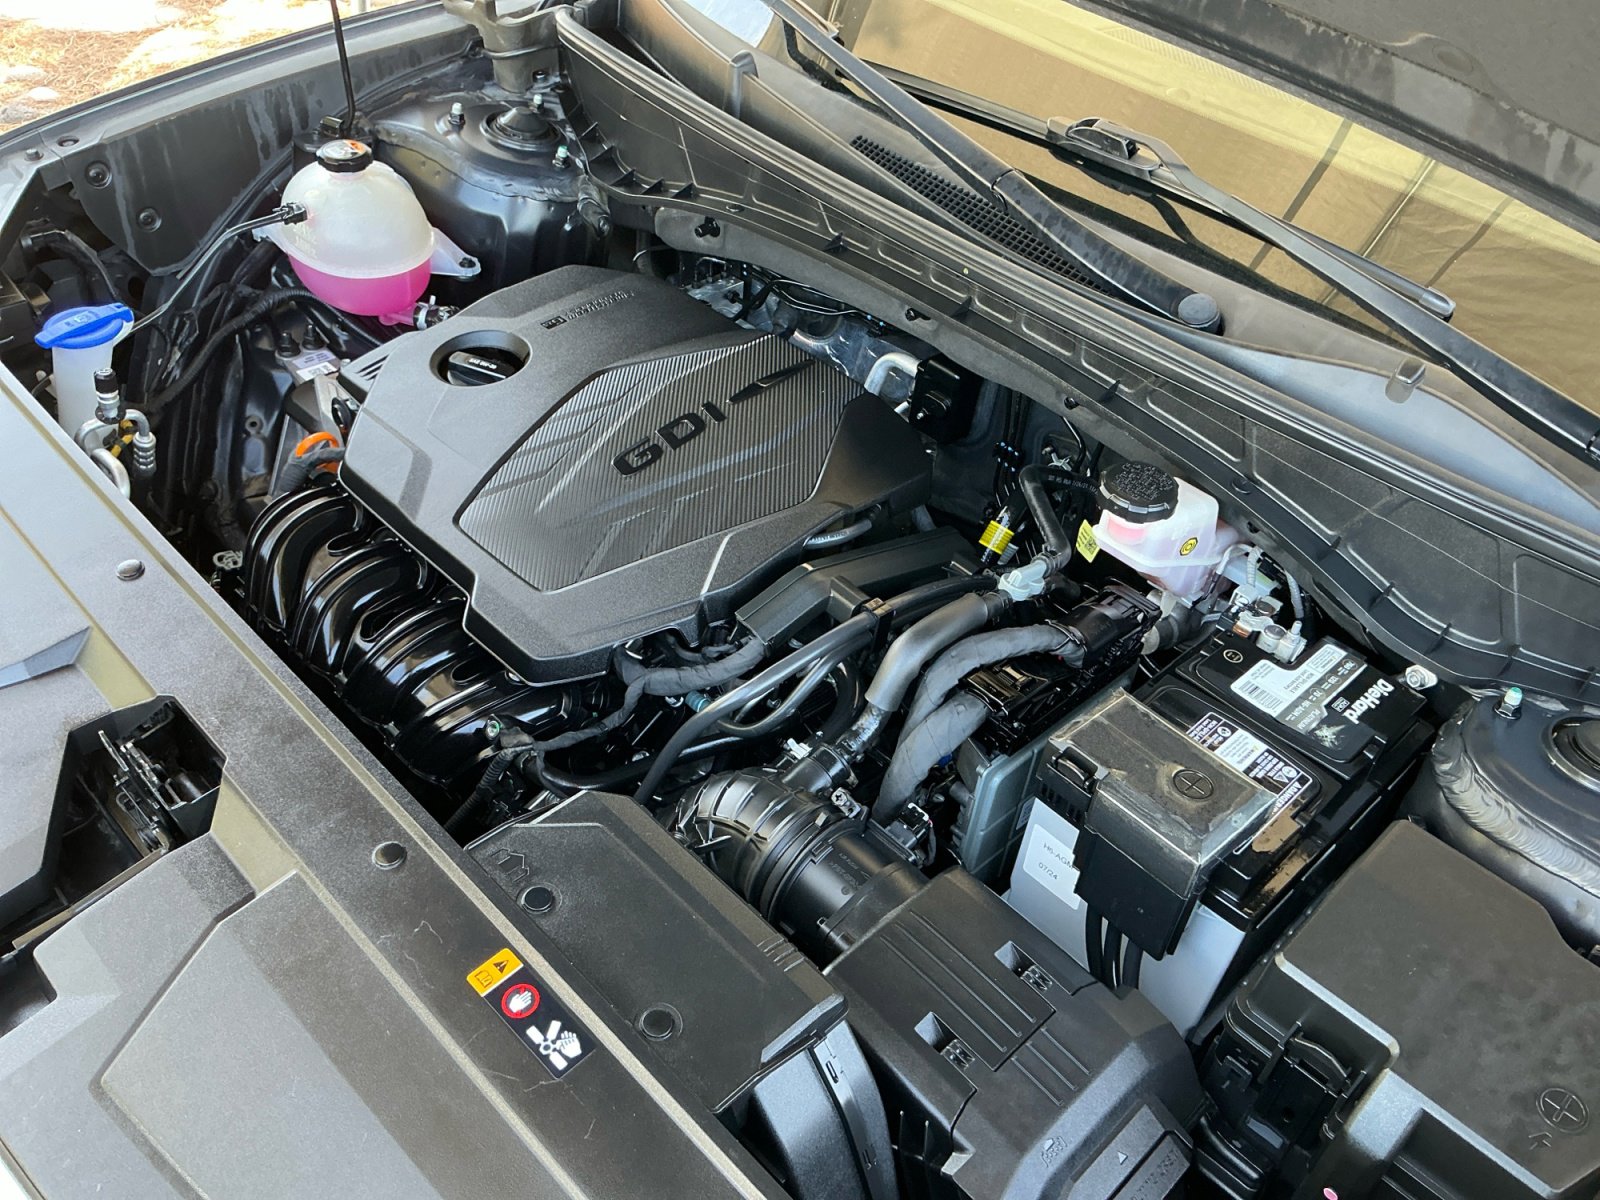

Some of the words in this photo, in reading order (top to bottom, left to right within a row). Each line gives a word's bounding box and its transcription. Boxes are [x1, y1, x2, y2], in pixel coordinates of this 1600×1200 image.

[611, 401, 727, 477] GDI
[1341, 678, 1394, 724] DieHard
[1296, 708, 1321, 729] PLATINUM
[1038, 862, 1058, 880] 07/24
